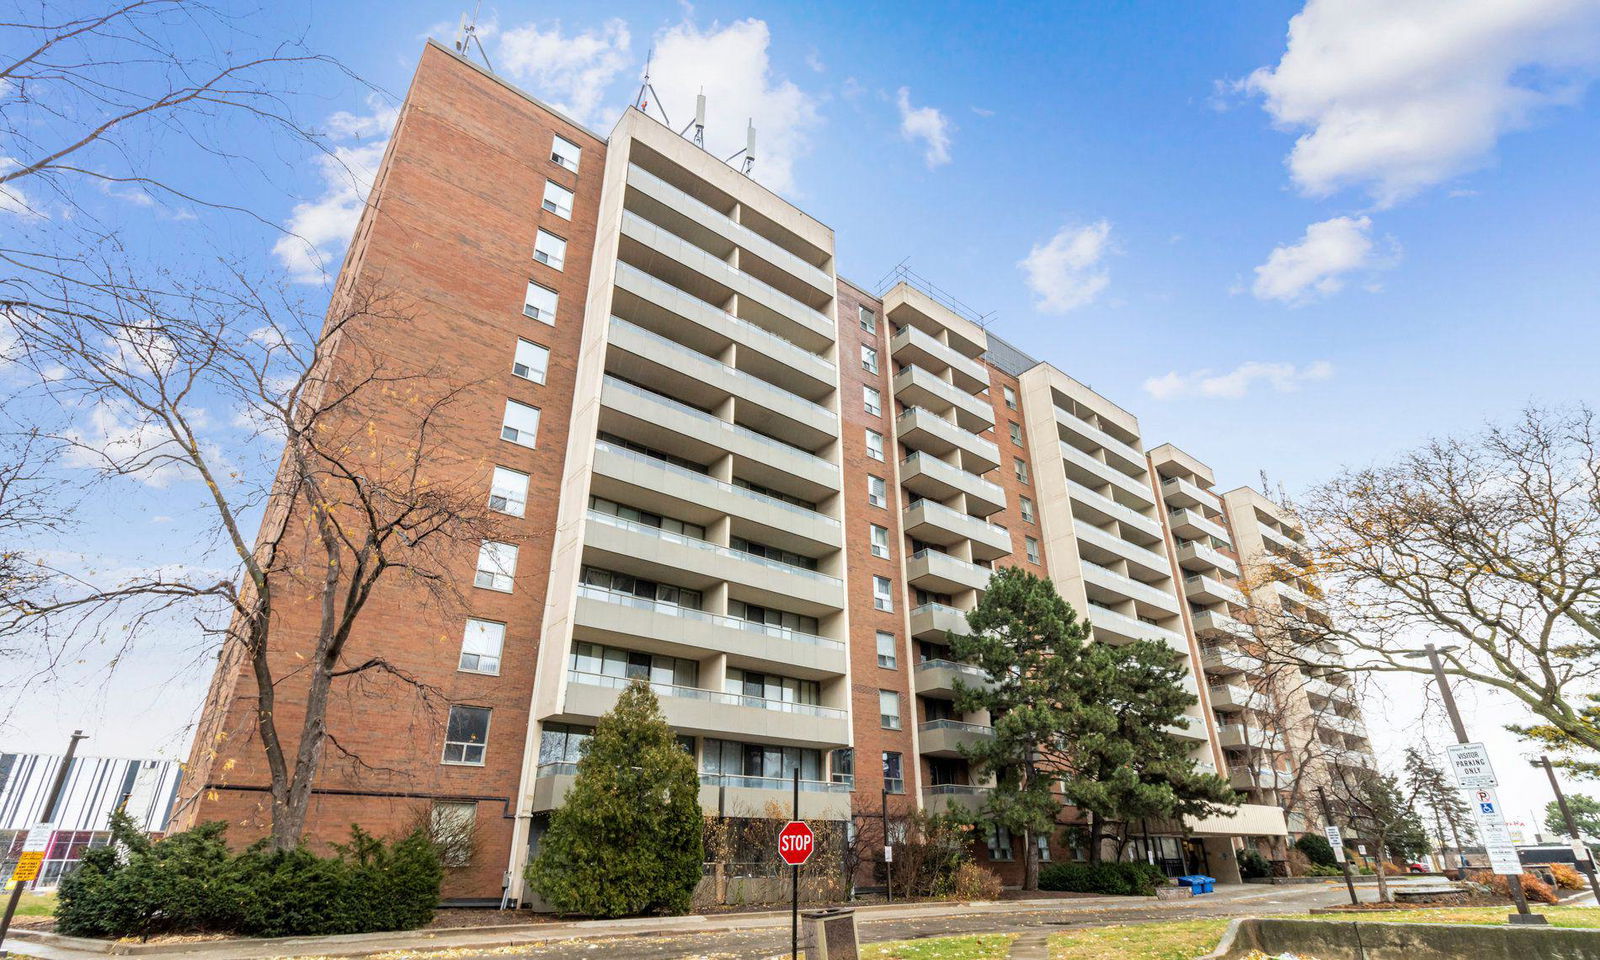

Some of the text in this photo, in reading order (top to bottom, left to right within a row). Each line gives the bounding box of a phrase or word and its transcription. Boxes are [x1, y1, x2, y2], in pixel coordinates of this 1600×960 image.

[1456, 751, 1480, 760] VISITOR
[1455, 758, 1485, 768] PARKING
[1464, 767, 1481, 775] ONLY
[781, 834, 811, 852] STOP
